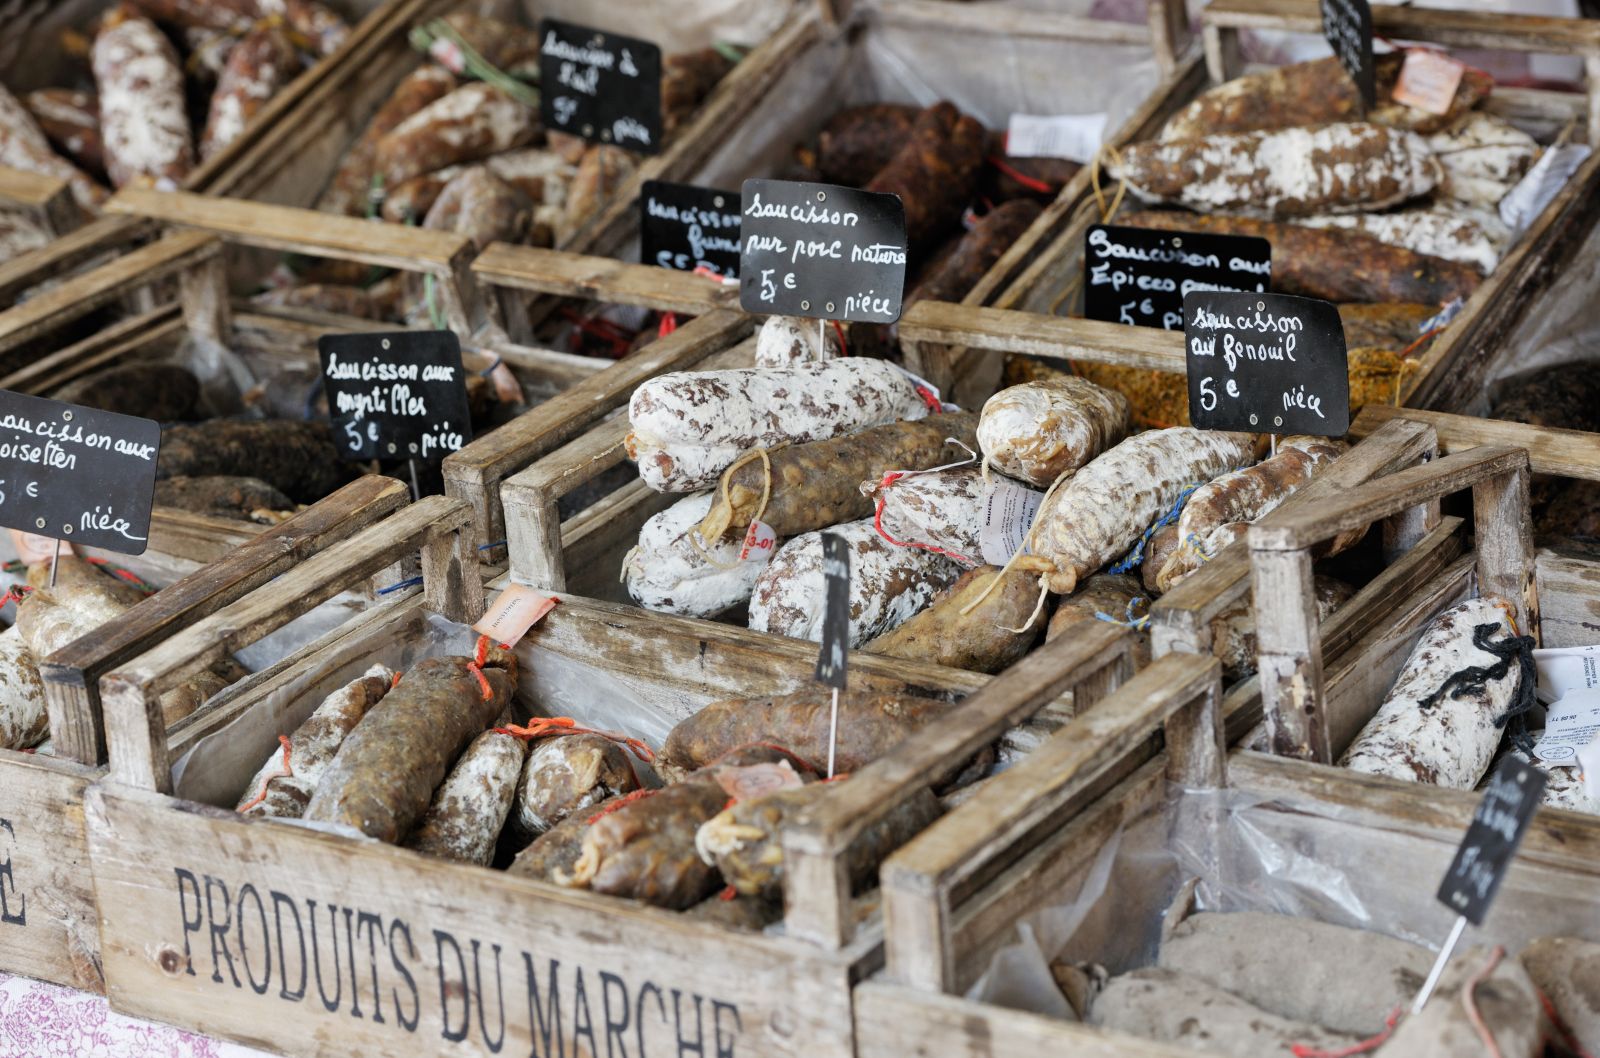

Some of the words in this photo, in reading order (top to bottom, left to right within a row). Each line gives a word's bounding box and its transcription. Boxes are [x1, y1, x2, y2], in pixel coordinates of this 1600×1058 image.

[745, 234, 788, 256] pur
[791, 239, 843, 265] porc
[851, 243, 907, 265] nature
[1223, 333, 1297, 372] fenouil
[422, 364, 455, 382] aux
[337, 383, 427, 421] myrtilles
[0, 414, 112, 450] aucisson
[114, 439, 156, 461] aux
[0, 435, 77, 470] oisettes
[173, 866, 421, 1033] PRODUITS
[432, 929, 505, 1054] DU
[521, 950, 744, 1058] MARCHE
